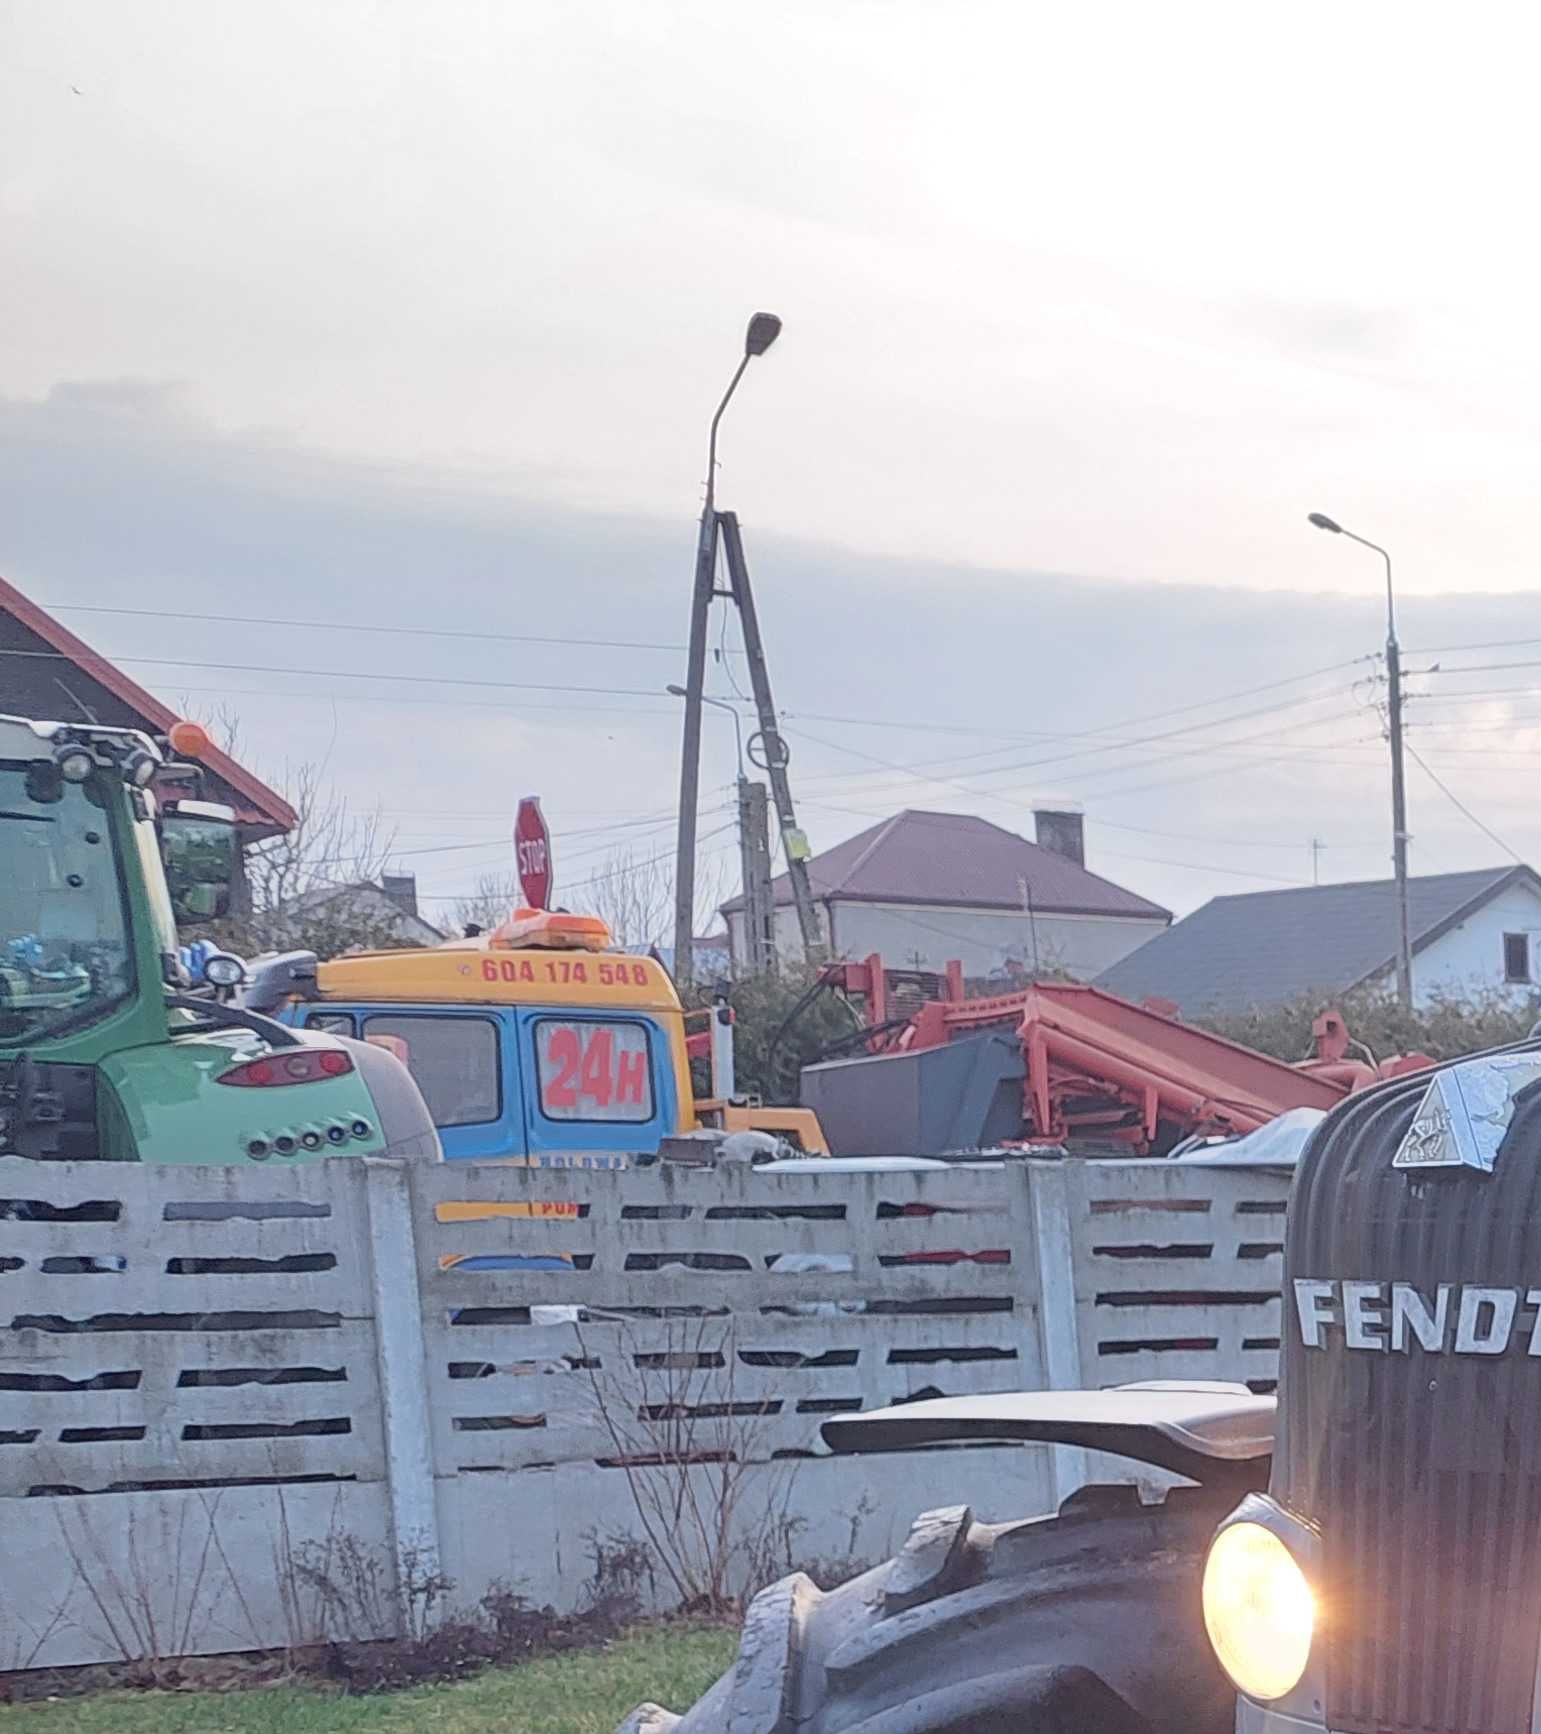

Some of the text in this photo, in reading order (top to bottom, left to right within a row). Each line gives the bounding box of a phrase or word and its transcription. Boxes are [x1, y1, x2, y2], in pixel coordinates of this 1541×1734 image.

[518, 837, 545, 875] STOP
[482, 959, 649, 987] 604 174 548
[546, 1027, 645, 1108] 24H
